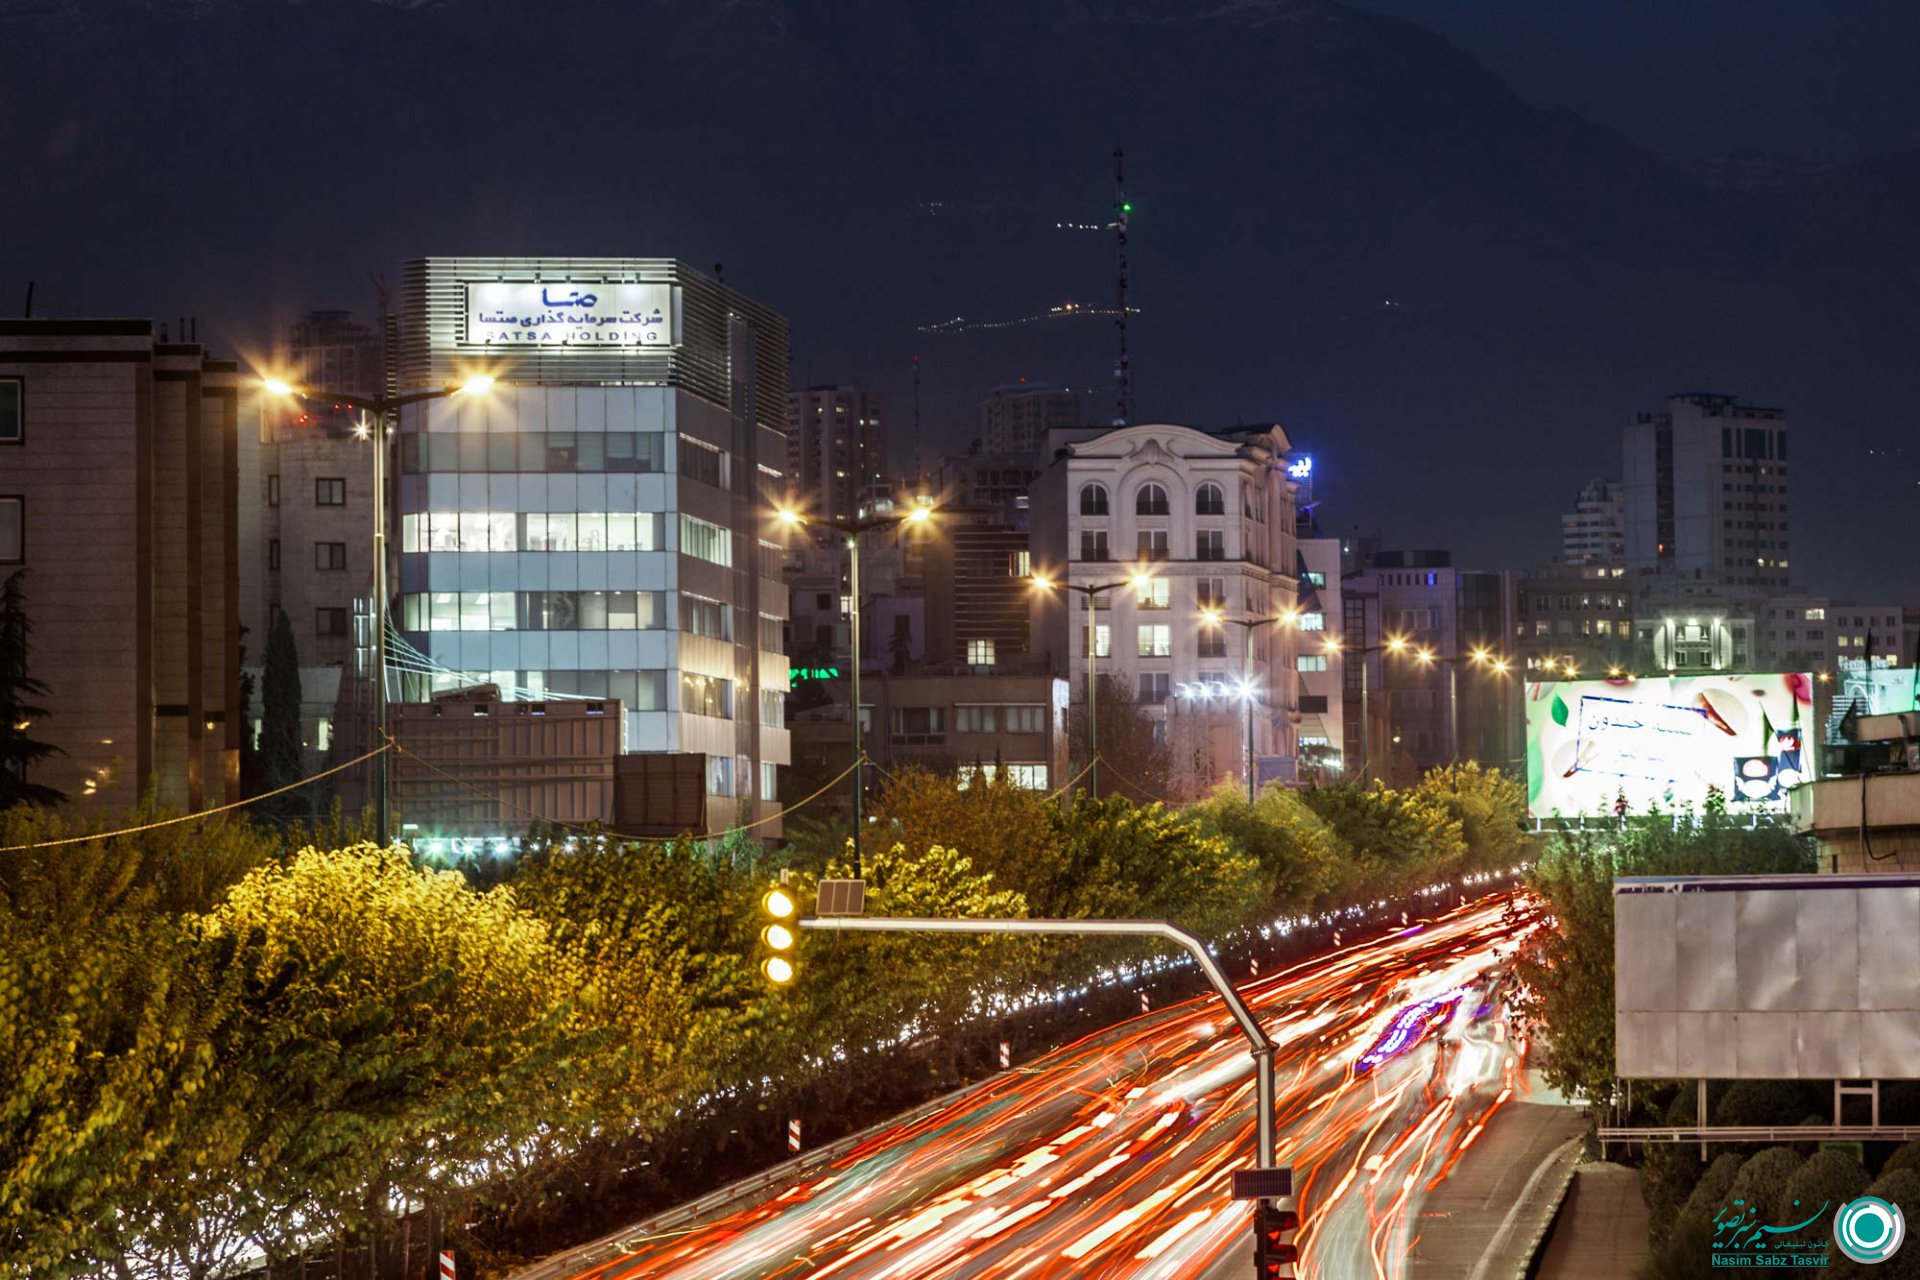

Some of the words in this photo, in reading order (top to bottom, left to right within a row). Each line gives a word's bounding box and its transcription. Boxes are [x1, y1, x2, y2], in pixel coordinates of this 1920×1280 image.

[519, 309, 565, 328] گذاری
[567, 312, 618, 330] سرمایه
[618, 308, 664, 326] شرکت
[486, 331, 552, 341] SATSA
[565, 331, 658, 341] HOLDING
